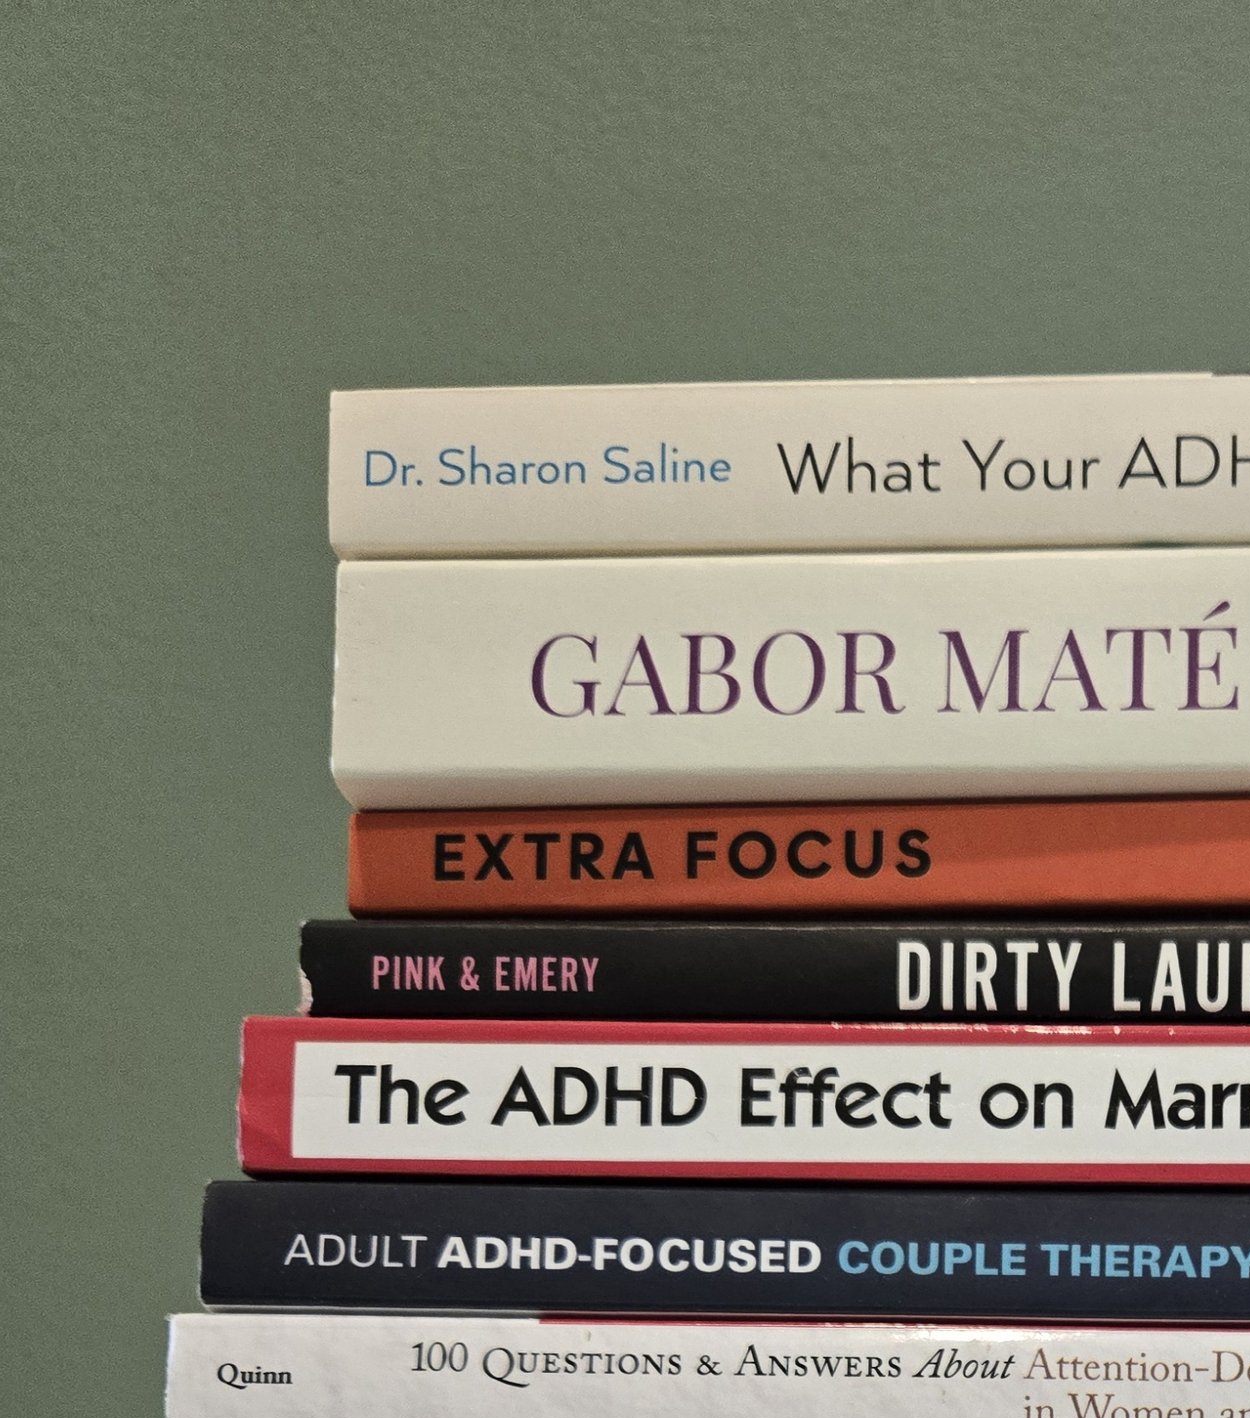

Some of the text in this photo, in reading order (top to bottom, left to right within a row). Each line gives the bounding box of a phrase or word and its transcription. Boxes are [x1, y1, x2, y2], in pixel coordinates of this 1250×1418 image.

[366, 443, 731, 486] Dr. Sharon Saline
[777, 437, 940, 494] What
[963, 440, 1100, 491] Your
[532, 601, 1238, 717] GABOR MATÉ
[434, 829, 930, 881] EXTRA FOCUS
[373, 956, 599, 992] PINK & EMERY
[898, 940, 1082, 1011] DIRTY
[335, 1064, 469, 1125] The
[491, 1066, 706, 1126] ADHD
[741, 1067, 951, 1128] Effect
[980, 1083, 1073, 1129] on
[284, 1234, 427, 1267] ADULT
[438, 1236, 821, 1273] ADHD-FOCUSED
[839, 1241, 1026, 1275] COUPLE
[217, 1363, 292, 1389] Quinn
[411, 1342, 468, 1372] 100
[483, 1348, 681, 1388] QUESTIONS
[697, 1355, 722, 1375] &
[734, 1345, 901, 1377] ANSWERS
[912, 1349, 1015, 1379] About
